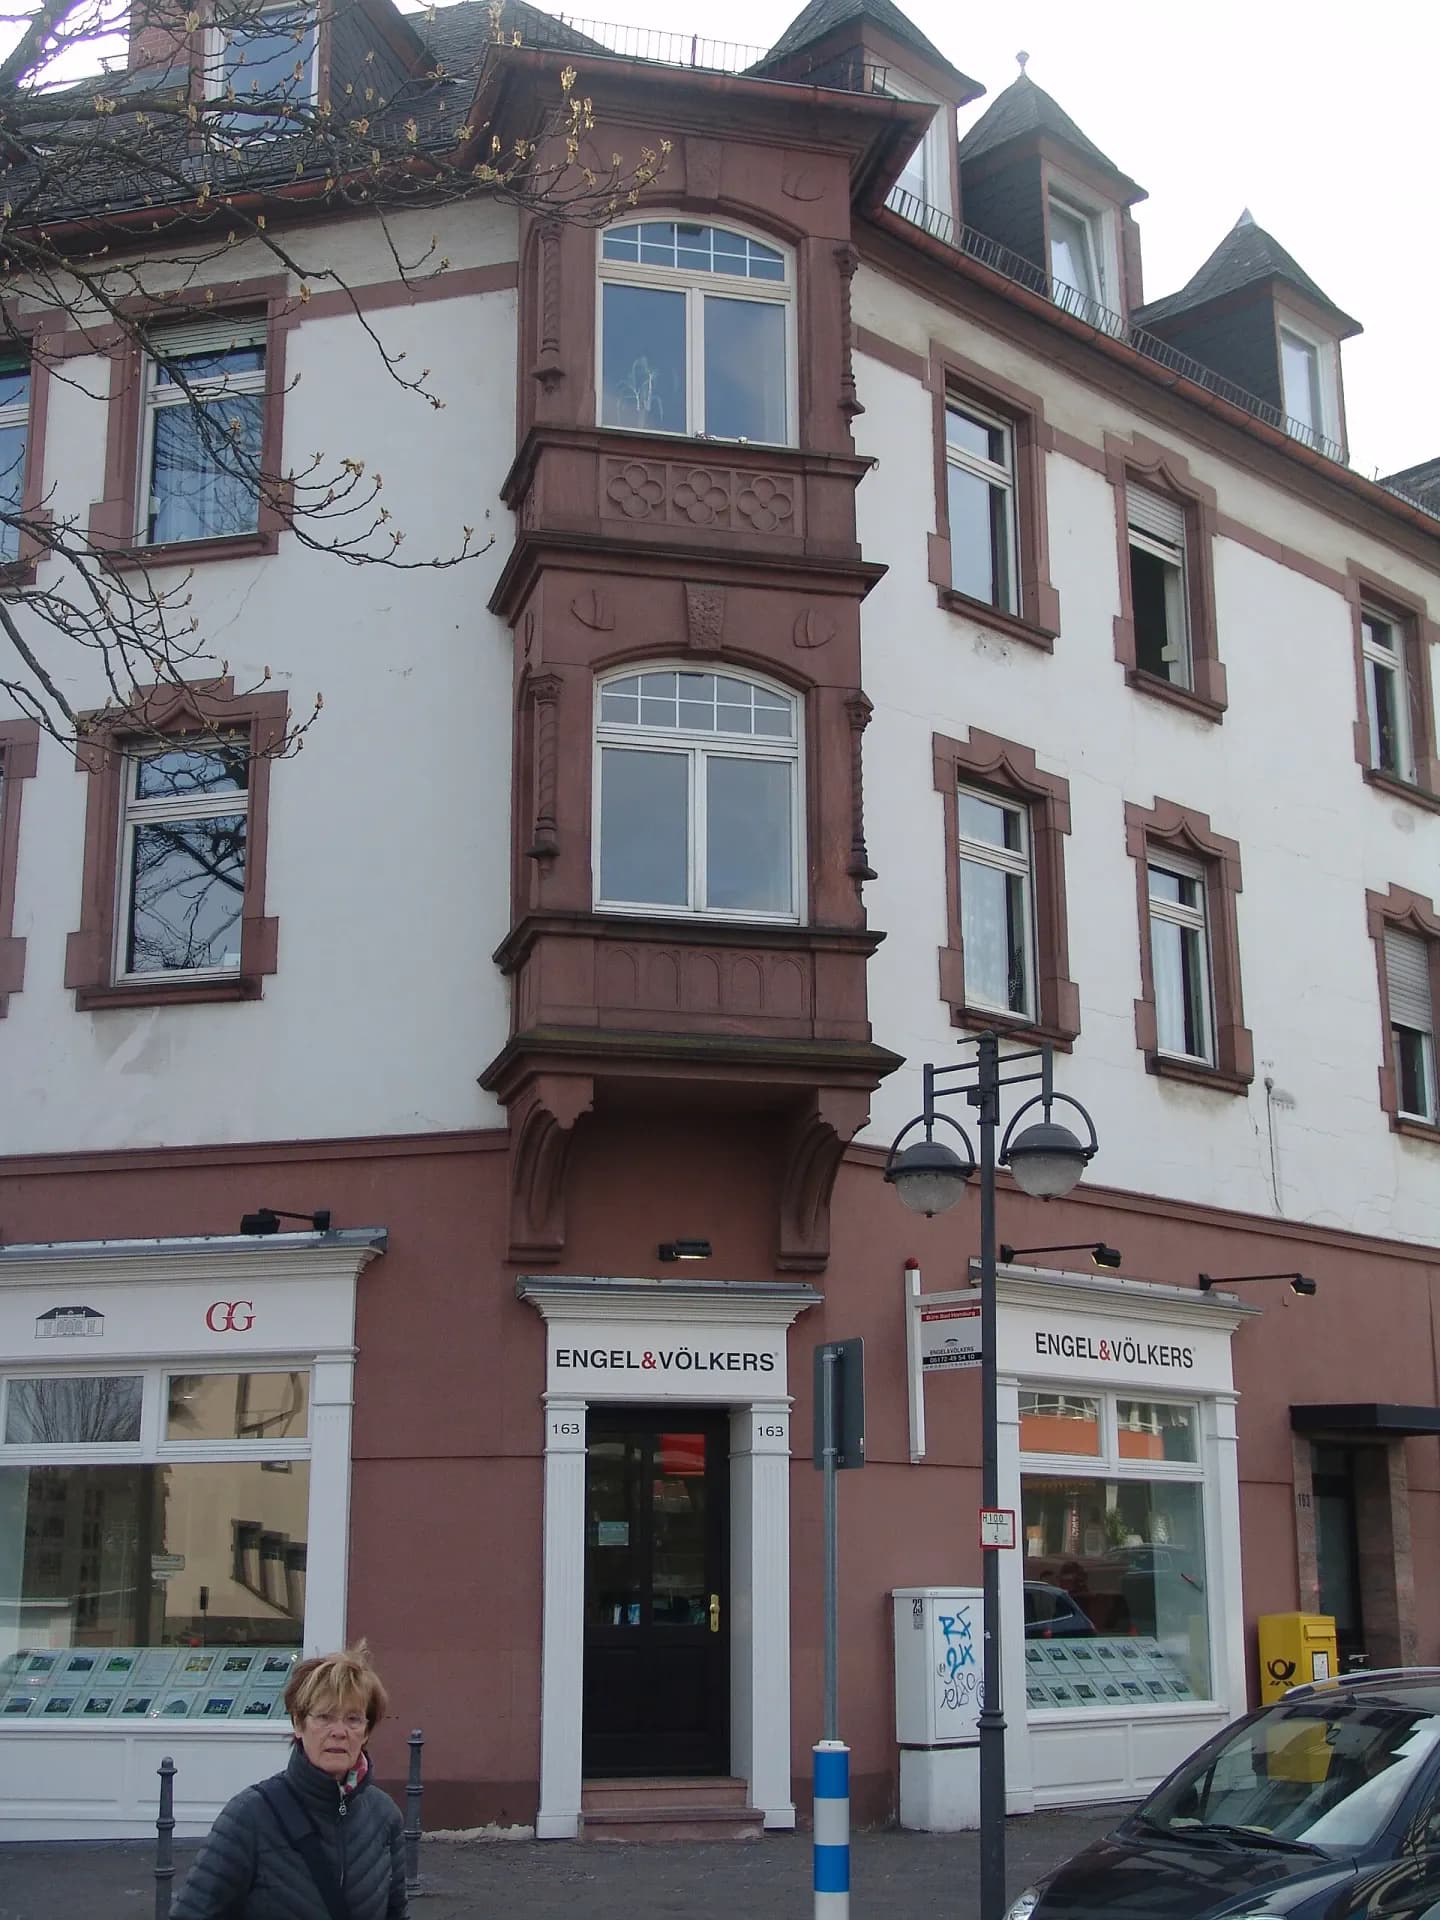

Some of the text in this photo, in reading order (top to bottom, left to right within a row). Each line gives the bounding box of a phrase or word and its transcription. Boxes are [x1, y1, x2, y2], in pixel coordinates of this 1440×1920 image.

[552, 1423, 580, 1435] 163
[757, 1425, 784, 1437] 163
[912, 1598, 923, 1614] 23
